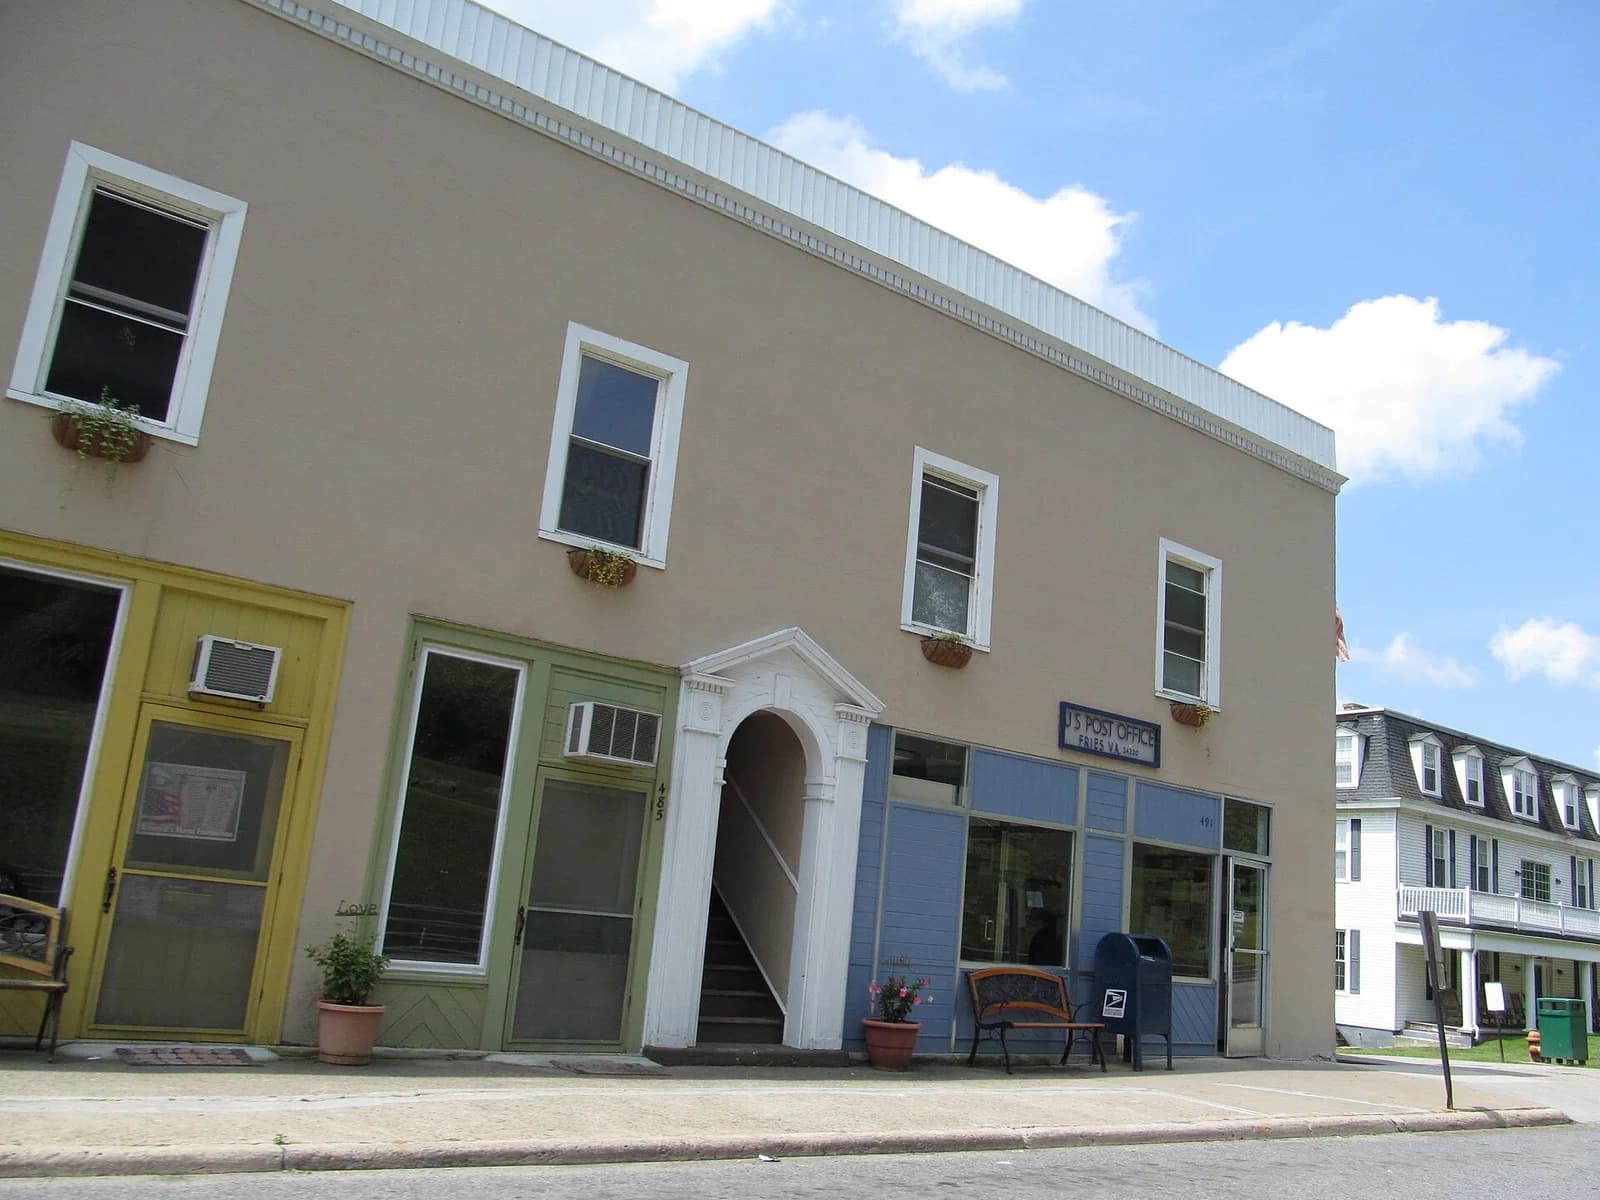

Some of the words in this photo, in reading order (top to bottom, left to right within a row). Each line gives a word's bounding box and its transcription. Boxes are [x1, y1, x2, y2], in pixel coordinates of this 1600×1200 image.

[1085, 715, 1114, 737] POST
[1117, 723, 1155, 746] OFFICE
[1079, 734, 1104, 751] FRIES
[656, 782, 666, 820] 485
[1200, 816, 1213, 828] 491
[336, 899, 377, 913] Love
